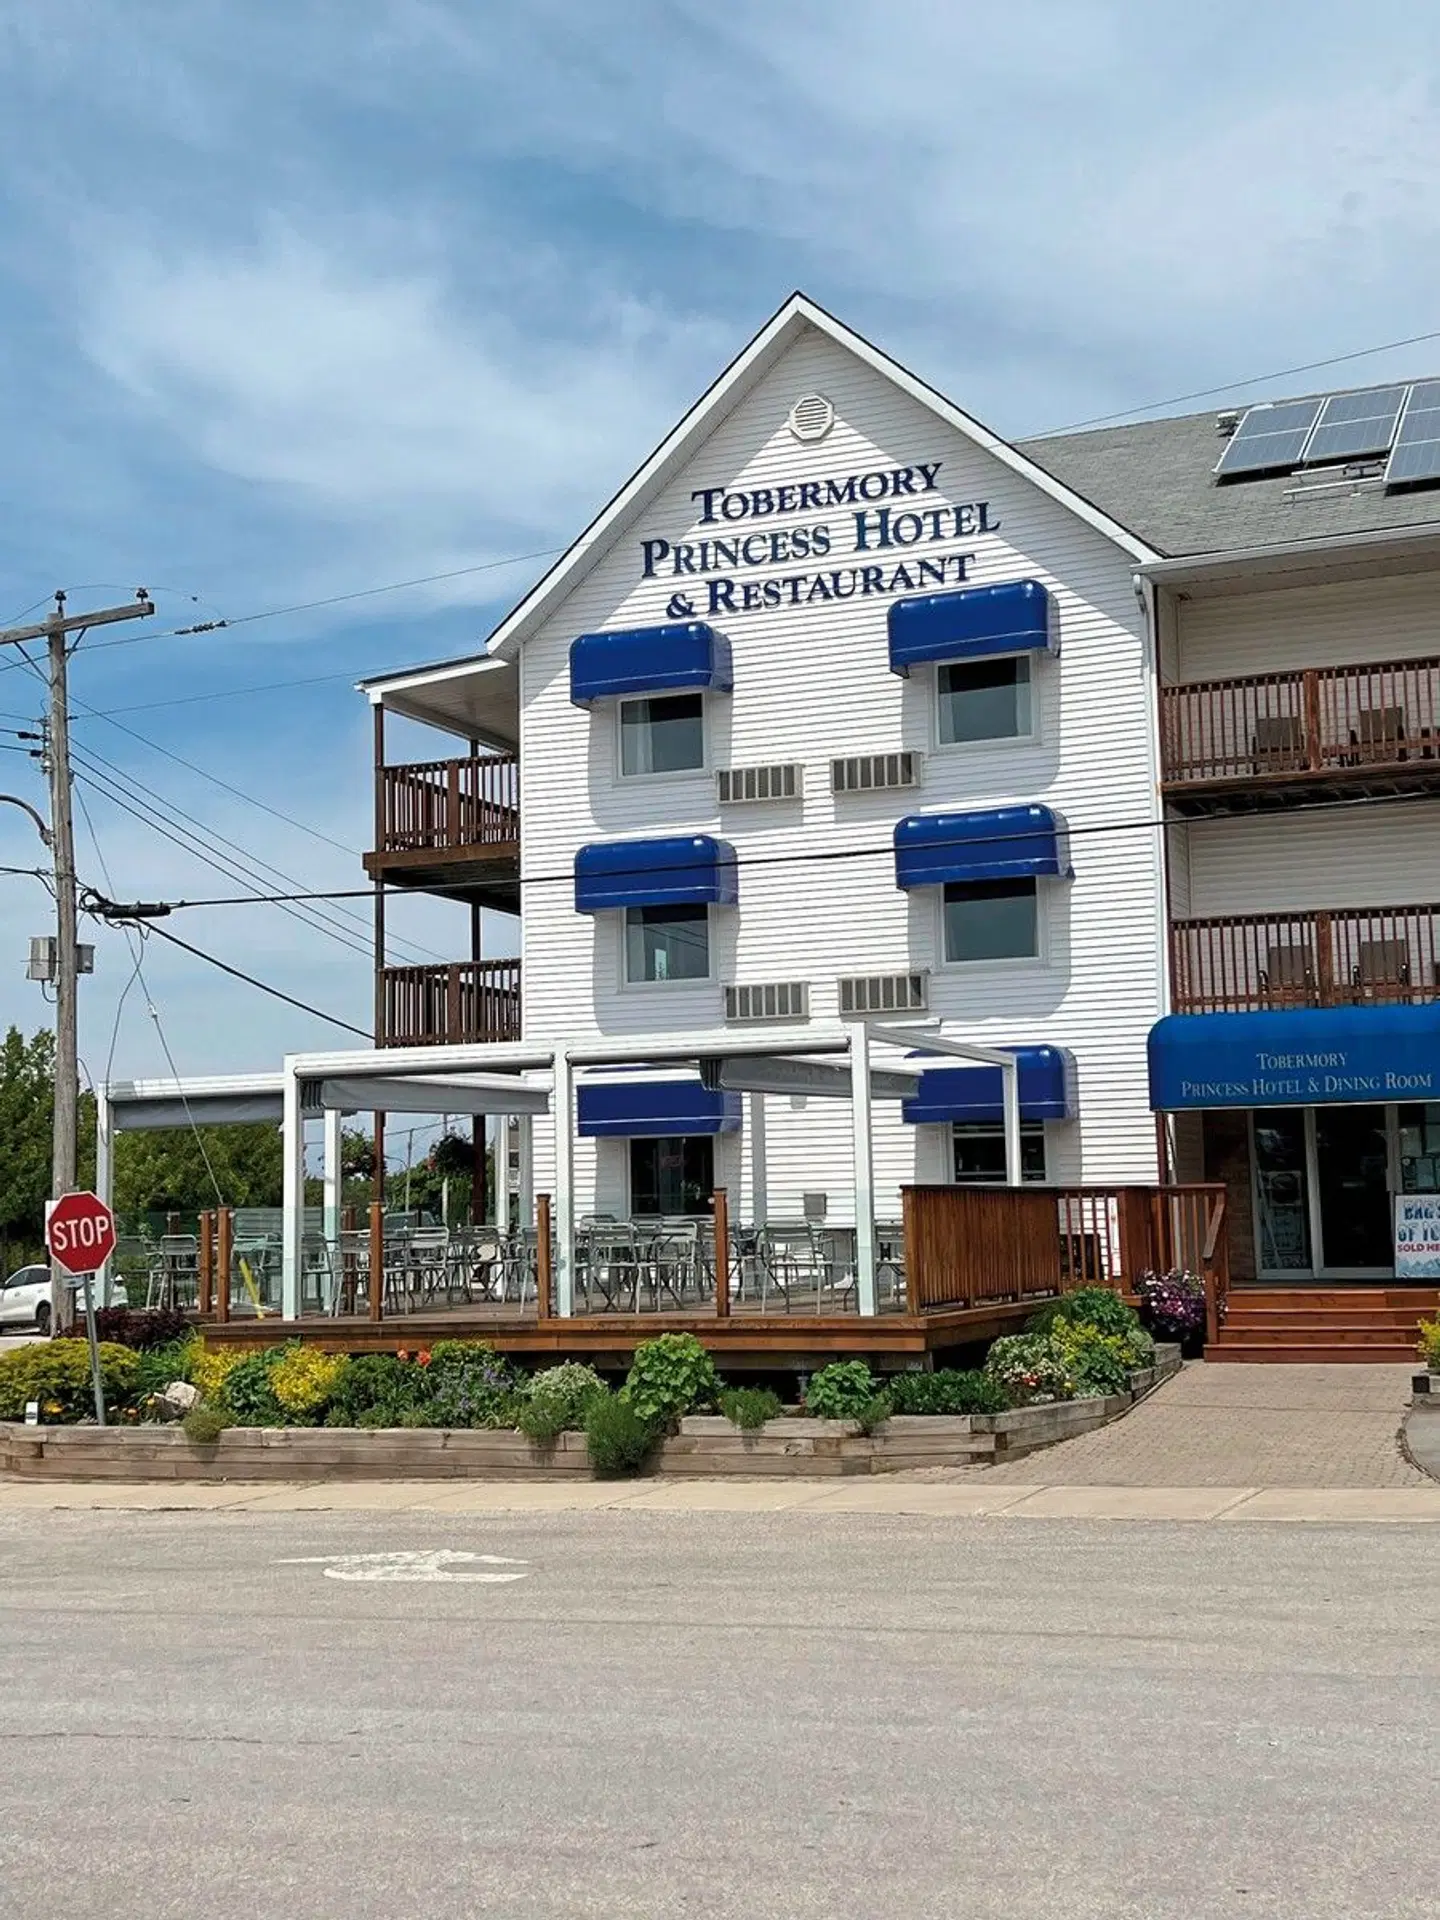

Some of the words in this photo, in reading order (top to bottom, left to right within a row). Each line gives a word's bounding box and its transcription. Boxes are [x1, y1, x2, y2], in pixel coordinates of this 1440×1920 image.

[692, 462, 944, 524] TOBERMORY
[640, 525, 830, 579] PRINCESS
[852, 502, 1000, 552] HOTEL
[666, 593, 697, 619] &
[706, 554, 976, 616] RESTAURANT
[1256, 1052, 1347, 1070] TOBERMORY
[1181, 1080, 1249, 1098] PRINCESS
[1252, 1078, 1303, 1095] HOTEL
[1308, 1077, 1320, 1093] &
[1324, 1075, 1380, 1094] DINING
[1384, 1072, 1432, 1089] ROOM
[52, 1215, 109, 1251] STOP
[1397, 1243, 1424, 1252] SOLD
